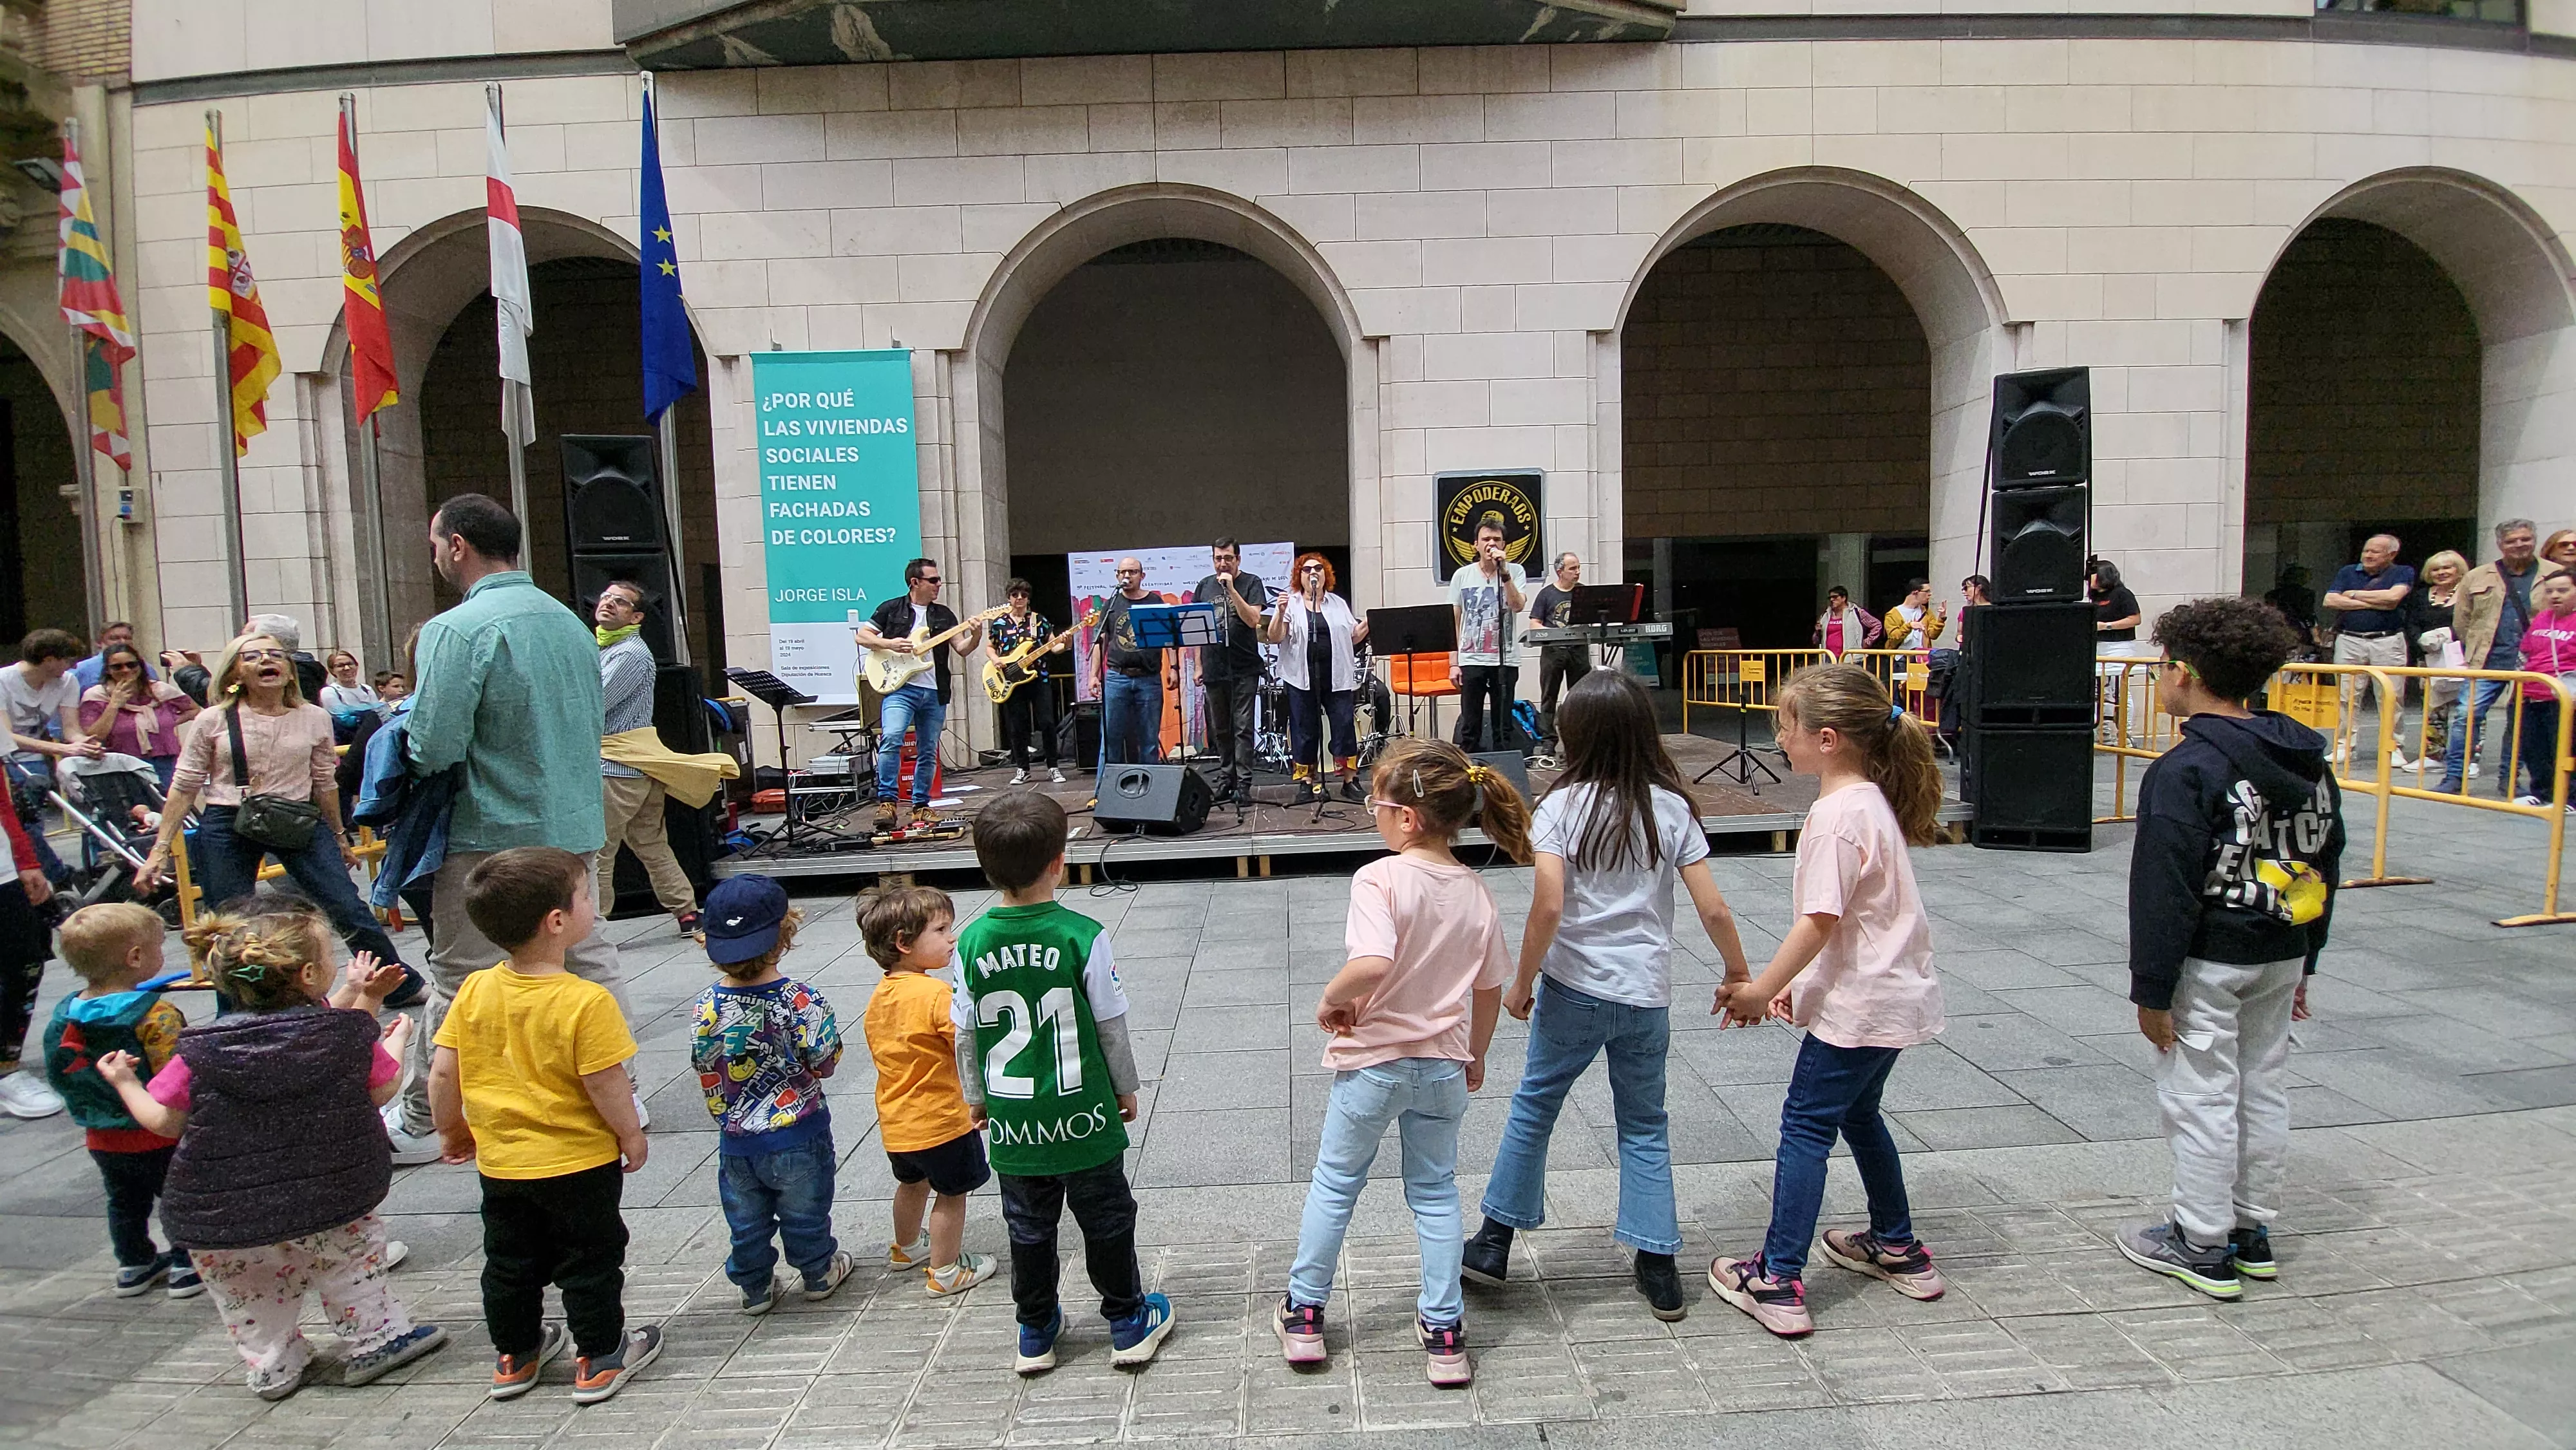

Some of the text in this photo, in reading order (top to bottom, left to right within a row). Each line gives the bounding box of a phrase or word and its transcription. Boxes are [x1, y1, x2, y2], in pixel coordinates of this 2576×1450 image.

[762, 388, 855, 412] ¿POR QUÉ
[764, 418, 907, 436] LAS VIVIENDAS
[766, 446, 859, 464] SOCIALES
[767, 475, 837, 491] TIENEN
[769, 501, 871, 518] FACHADAS
[1450, 486, 1531, 525] EMPODERAOS
[772, 527, 896, 545] DE COLORES?
[775, 588, 867, 602] JORGE ISLA
[1645, 624, 1667, 634] KORG
[976, 943, 1060, 979] MATEO
[976, 987, 1083, 1099] 21
[781, 1095, 805, 1115] CHILL
[989, 1103, 1106, 1145] OMMOS
